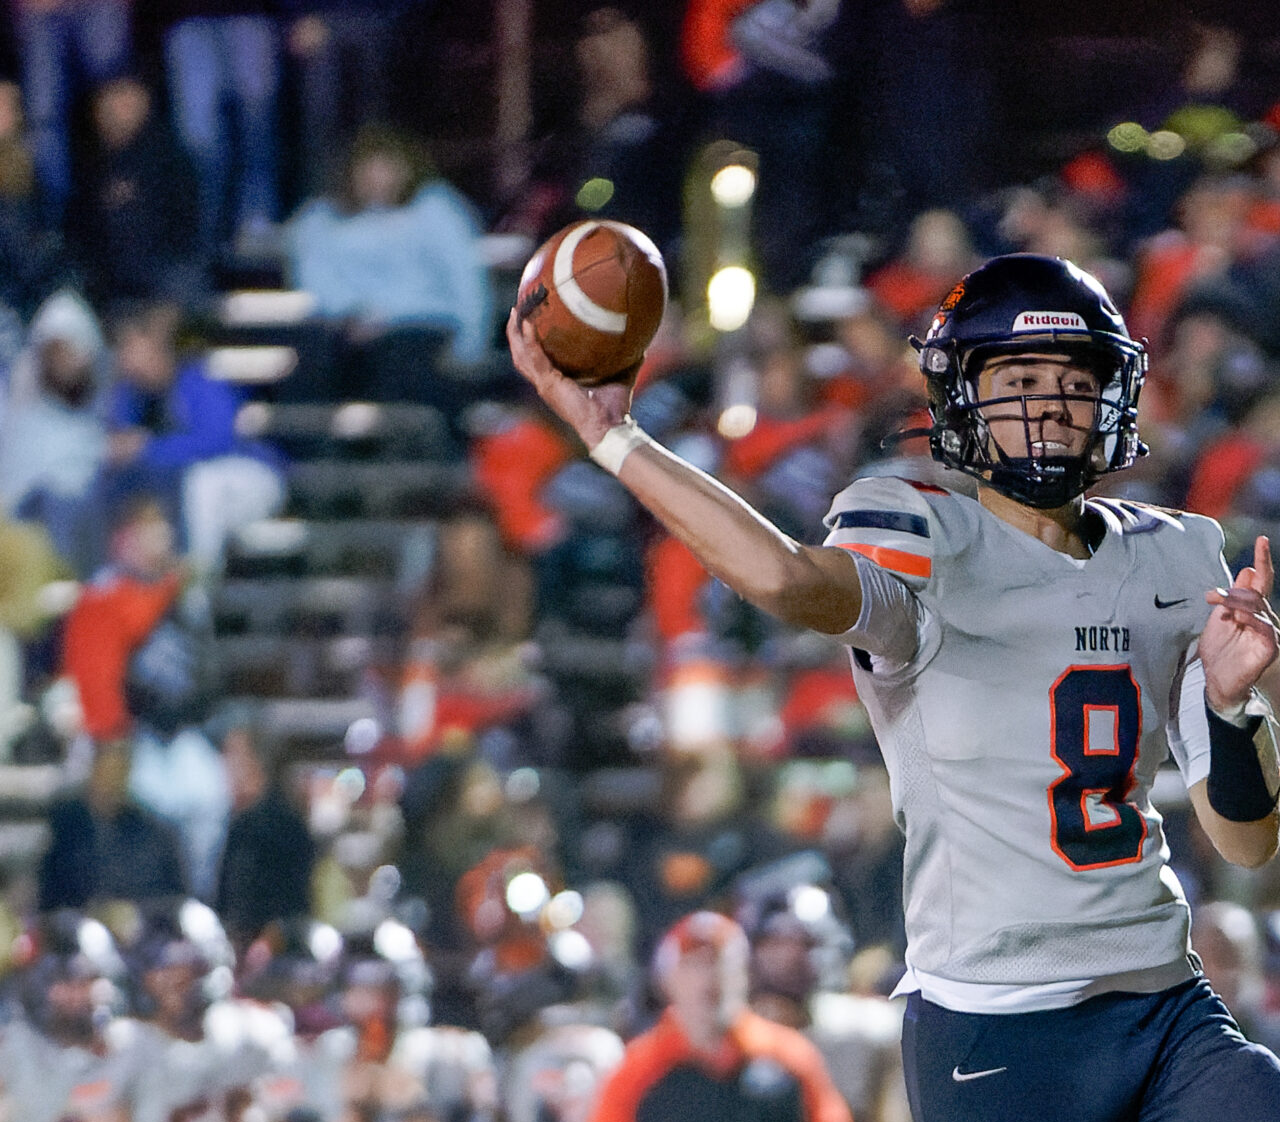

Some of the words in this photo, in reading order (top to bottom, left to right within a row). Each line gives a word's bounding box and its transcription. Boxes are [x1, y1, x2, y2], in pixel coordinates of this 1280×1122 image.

[1023, 315, 1079, 326] Riddell
[1075, 626, 1130, 651] NORTH
[1047, 664, 1148, 872] 8
